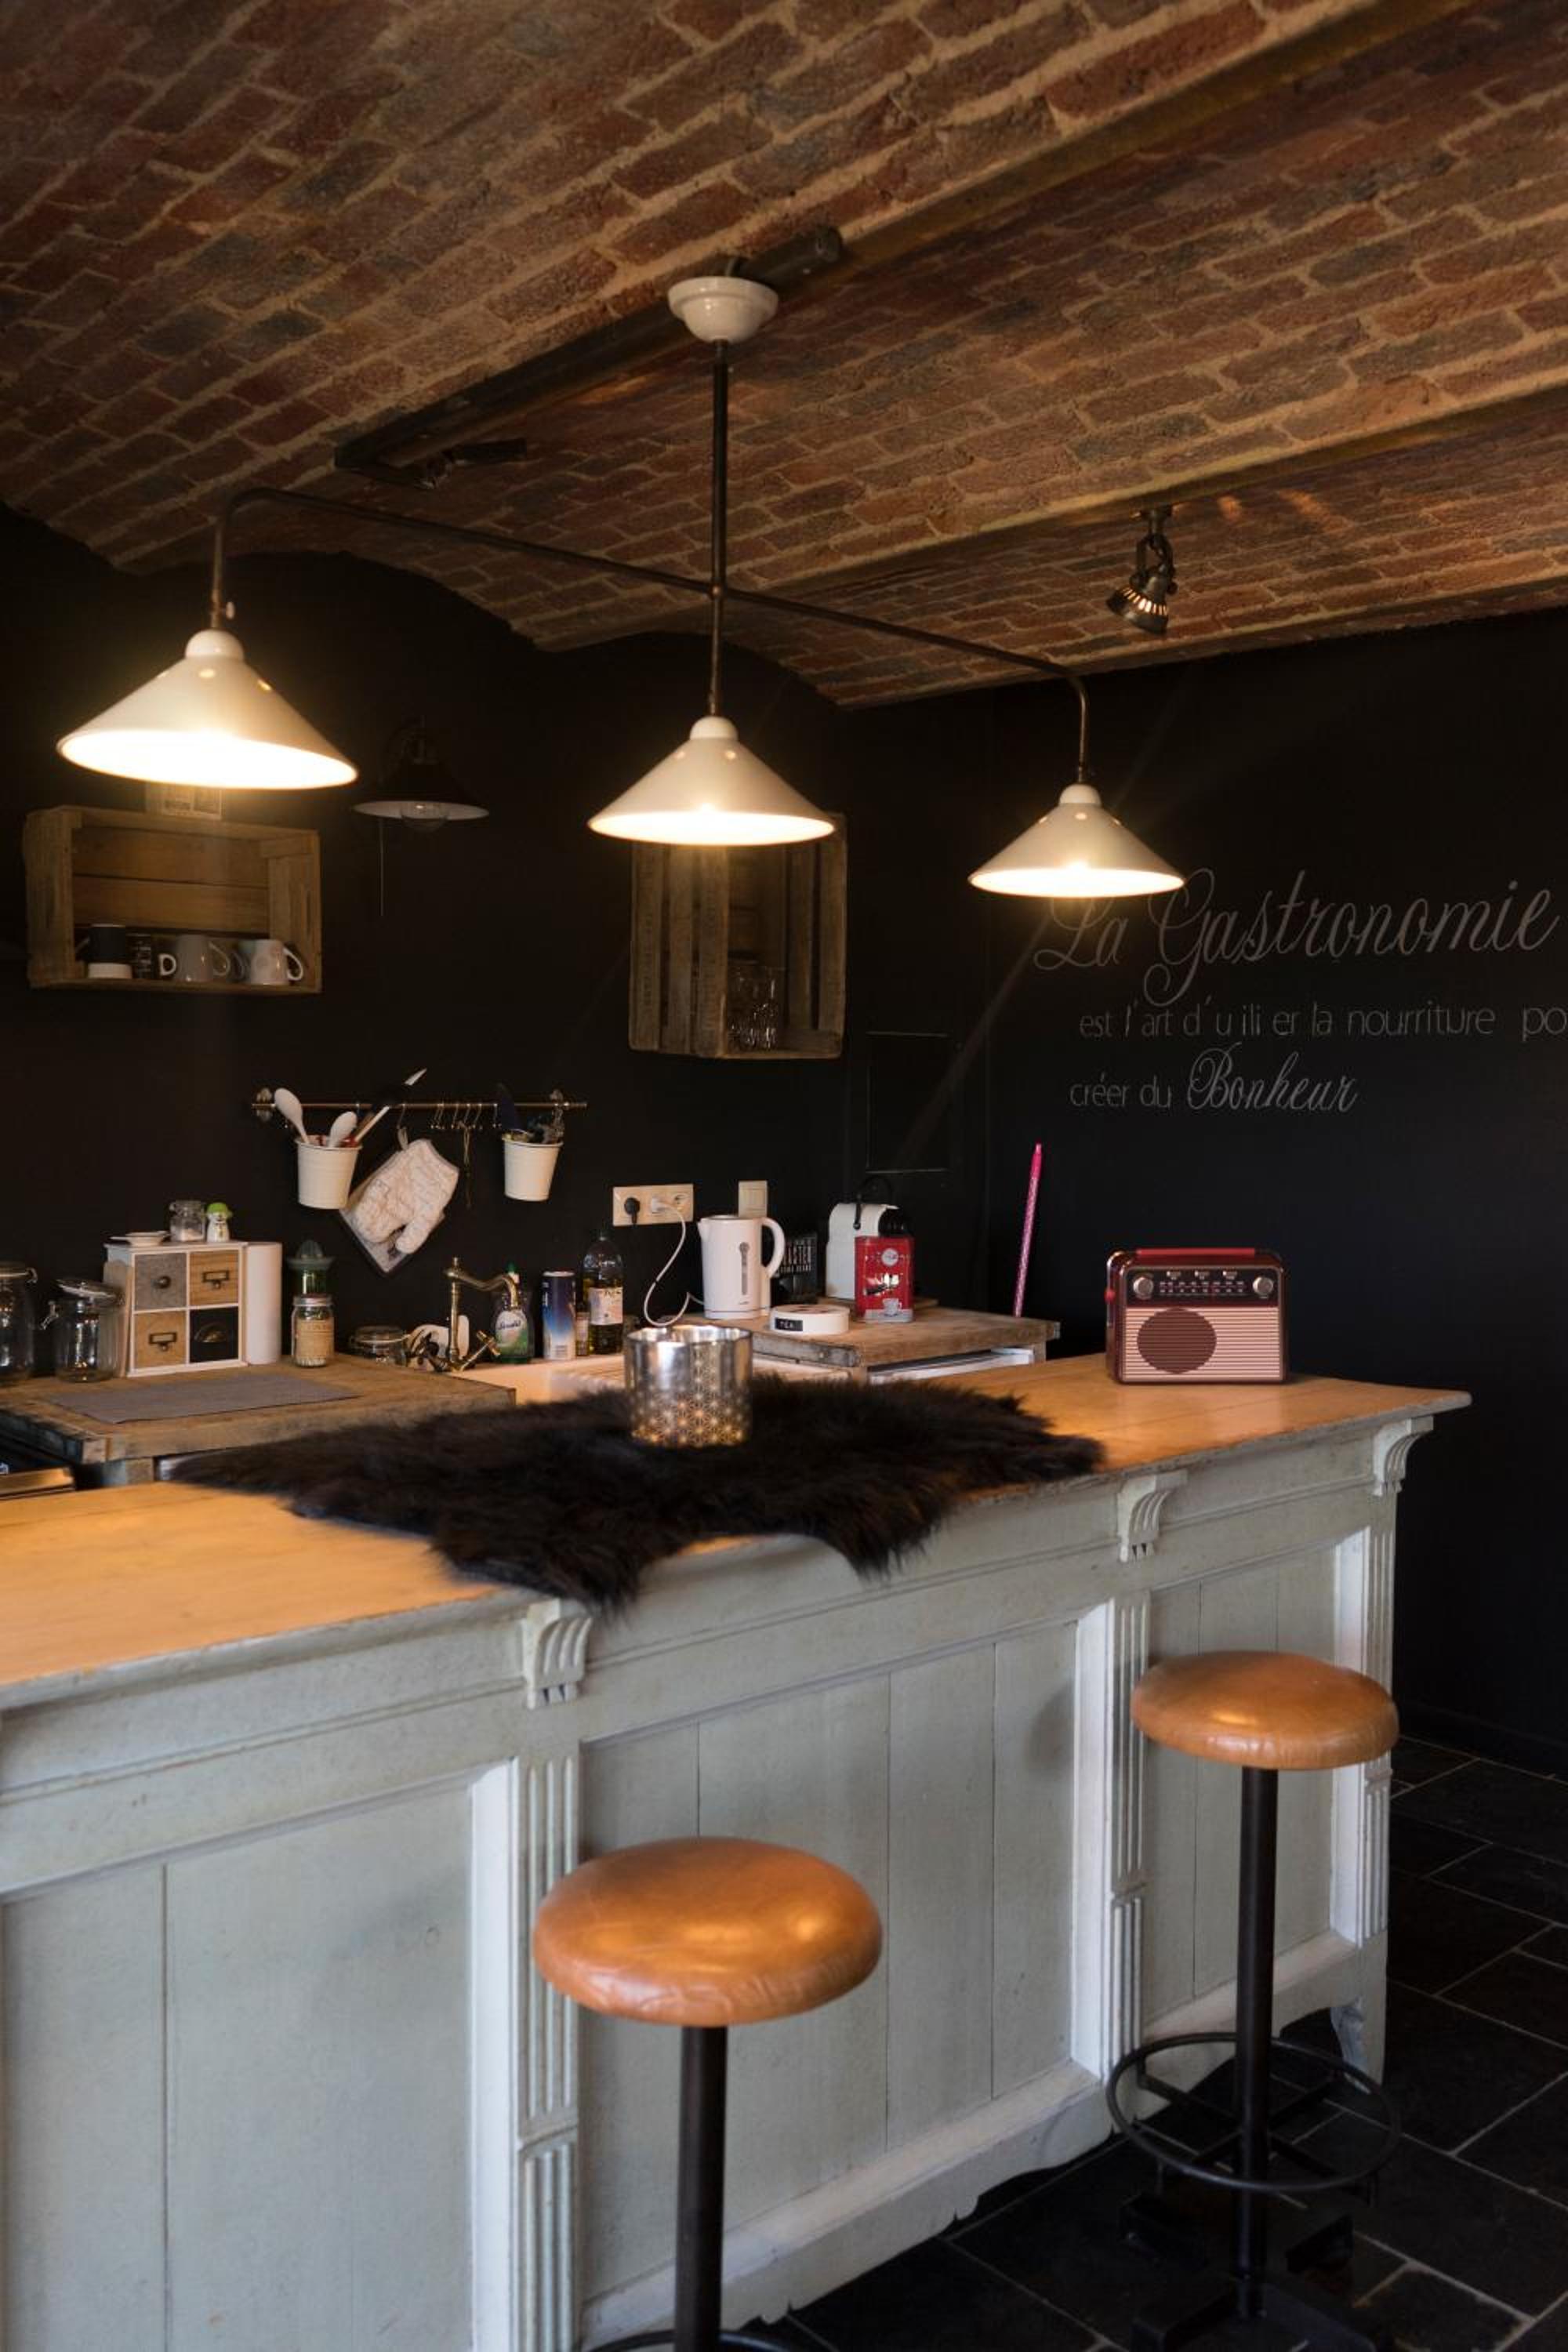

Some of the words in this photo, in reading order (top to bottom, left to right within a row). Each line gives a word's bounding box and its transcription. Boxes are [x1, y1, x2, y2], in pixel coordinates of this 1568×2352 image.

[1033, 897, 1129, 971] La
[1142, 866, 1560, 1007] Gastronomie
[1079, 1011, 1112, 1038] est
[1312, 1001, 1334, 1036] la
[1347, 999, 1495, 1036] nourriture
[1068, 1071, 1129, 1108] créer
[1139, 1073, 1173, 1109] du
[1187, 1040, 1358, 1112] Bonheur
